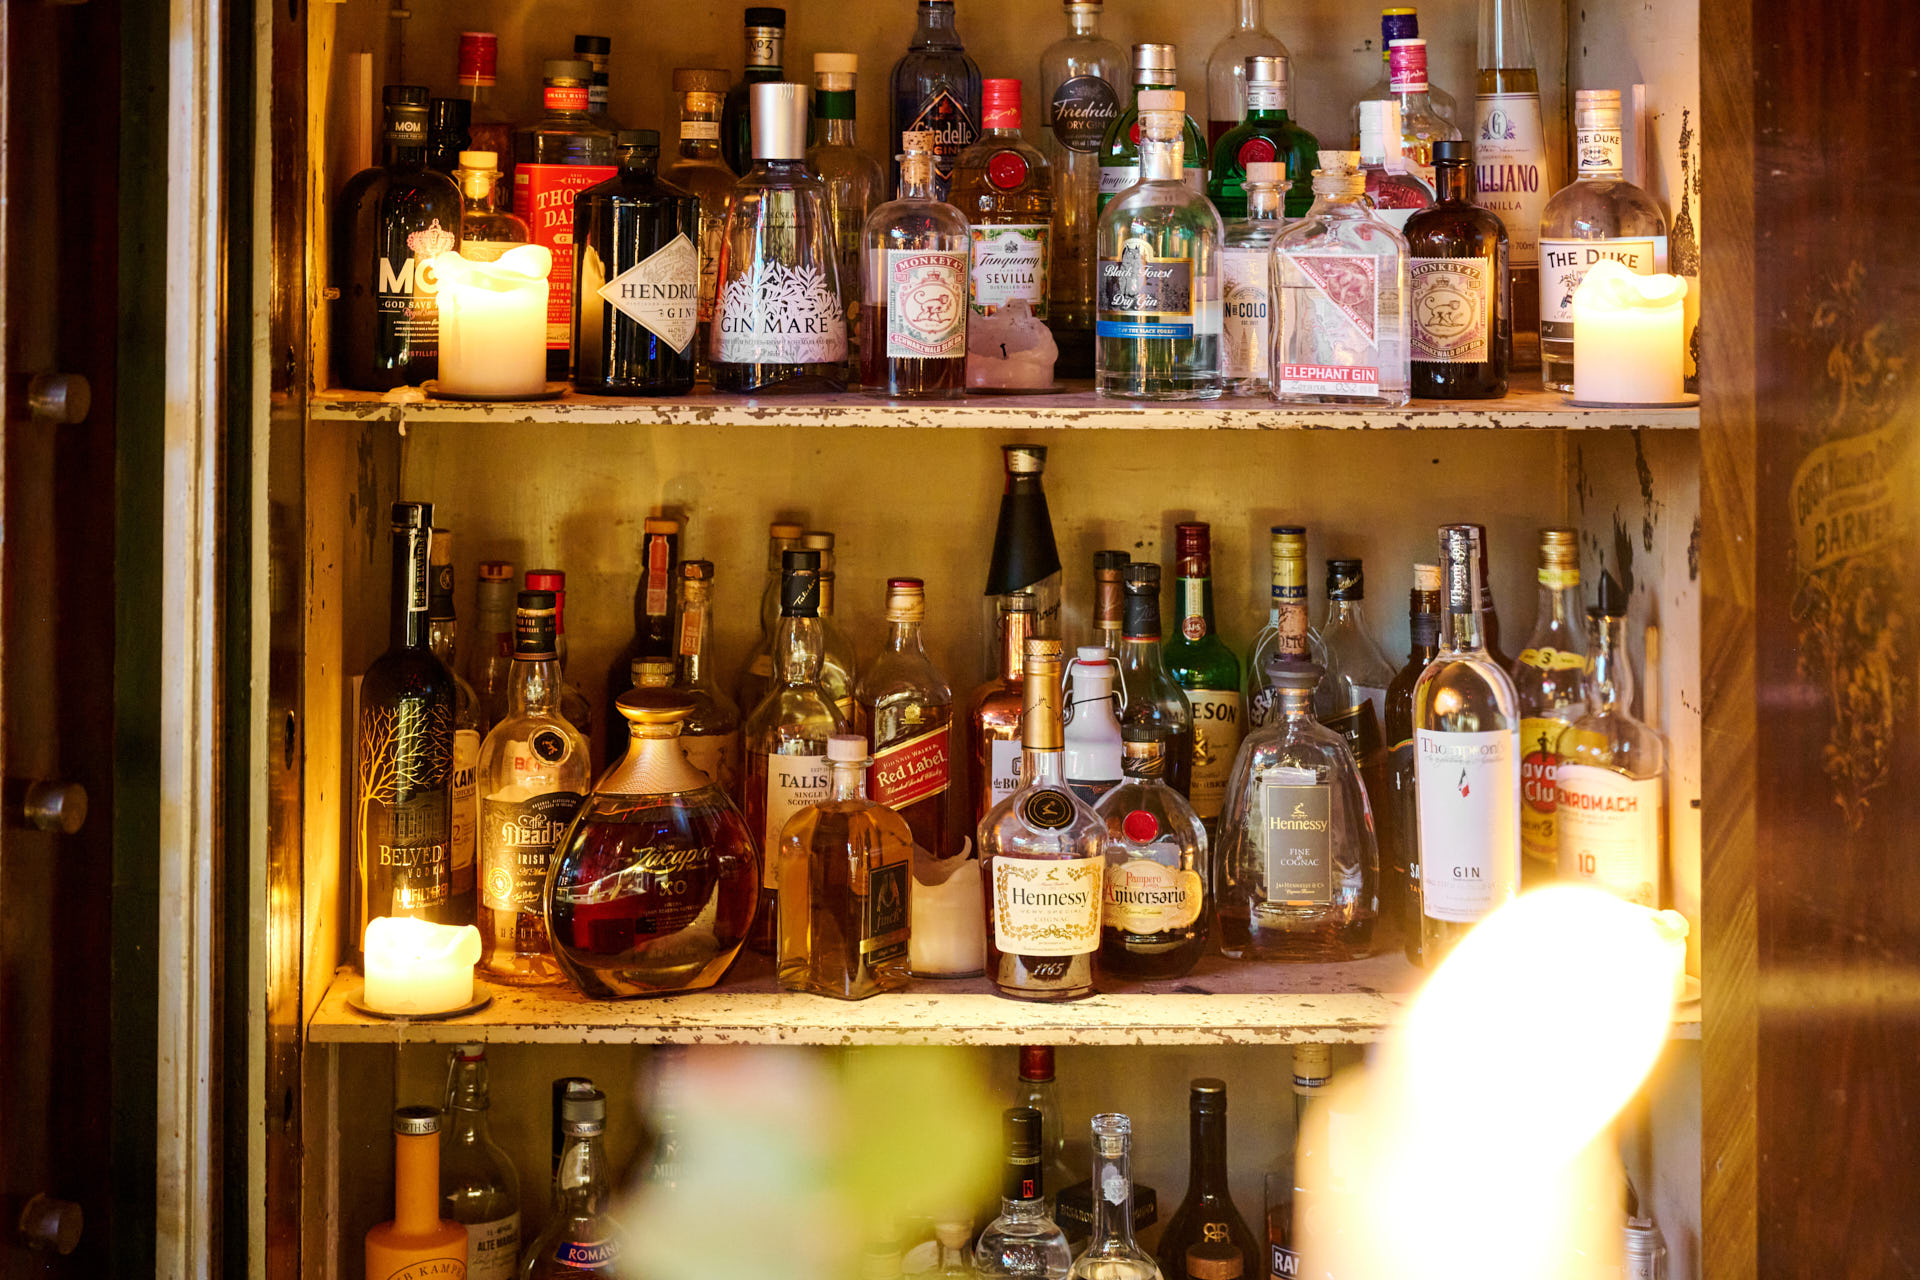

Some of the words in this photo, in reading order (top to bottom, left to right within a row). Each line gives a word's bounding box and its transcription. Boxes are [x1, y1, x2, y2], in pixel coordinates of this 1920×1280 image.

[1052, 98, 1118, 121] Friedrichs
[395, 121, 421, 132] MOM
[1593, 133, 1620, 145] DUKE
[537, 188, 574, 210] THO
[898, 255, 952, 271] MONKEY
[952, 262, 963, 270] 47
[979, 252, 1040, 268] Tanqueray
[1547, 252, 1577, 269] THE
[1103, 264, 1133, 278] Black
[1138, 265, 1174, 279] Forest
[1411, 263, 1464, 276] MONKEY
[1464, 266, 1480, 277] 47
[986, 273, 1035, 284] SEVILLA
[409, 301, 432, 309] SAVE
[1110, 293, 1135, 308] Dry
[1136, 293, 1159, 312] Gin
[720, 316, 755, 333] GIN
[764, 317, 829, 334] MARE
[1284, 365, 1350, 380] ELEPHANT
[1351, 369, 1376, 381] GIN
[1541, 651, 1552, 664] 3
[876, 764, 907, 788] Red
[906, 748, 945, 776] Label
[1270, 816, 1328, 833] Hennessy
[1541, 820, 1554, 838] 3
[502, 820, 550, 847] Dead
[518, 853, 545, 865] IRISH
[1289, 848, 1311, 856] FINE
[1280, 858, 1320, 867] COGNAC
[1578, 853, 1596, 873] 10
[1125, 871, 1163, 888] Pampero
[1452, 866, 1481, 878] GIN
[1012, 887, 1090, 908] Hennessy
[1105, 881, 1187, 909] Aniversario
[1033, 962, 1064, 976] 1765
[421, 1122, 438, 1133] SEA
[1024, 1181, 1032, 1197] K
